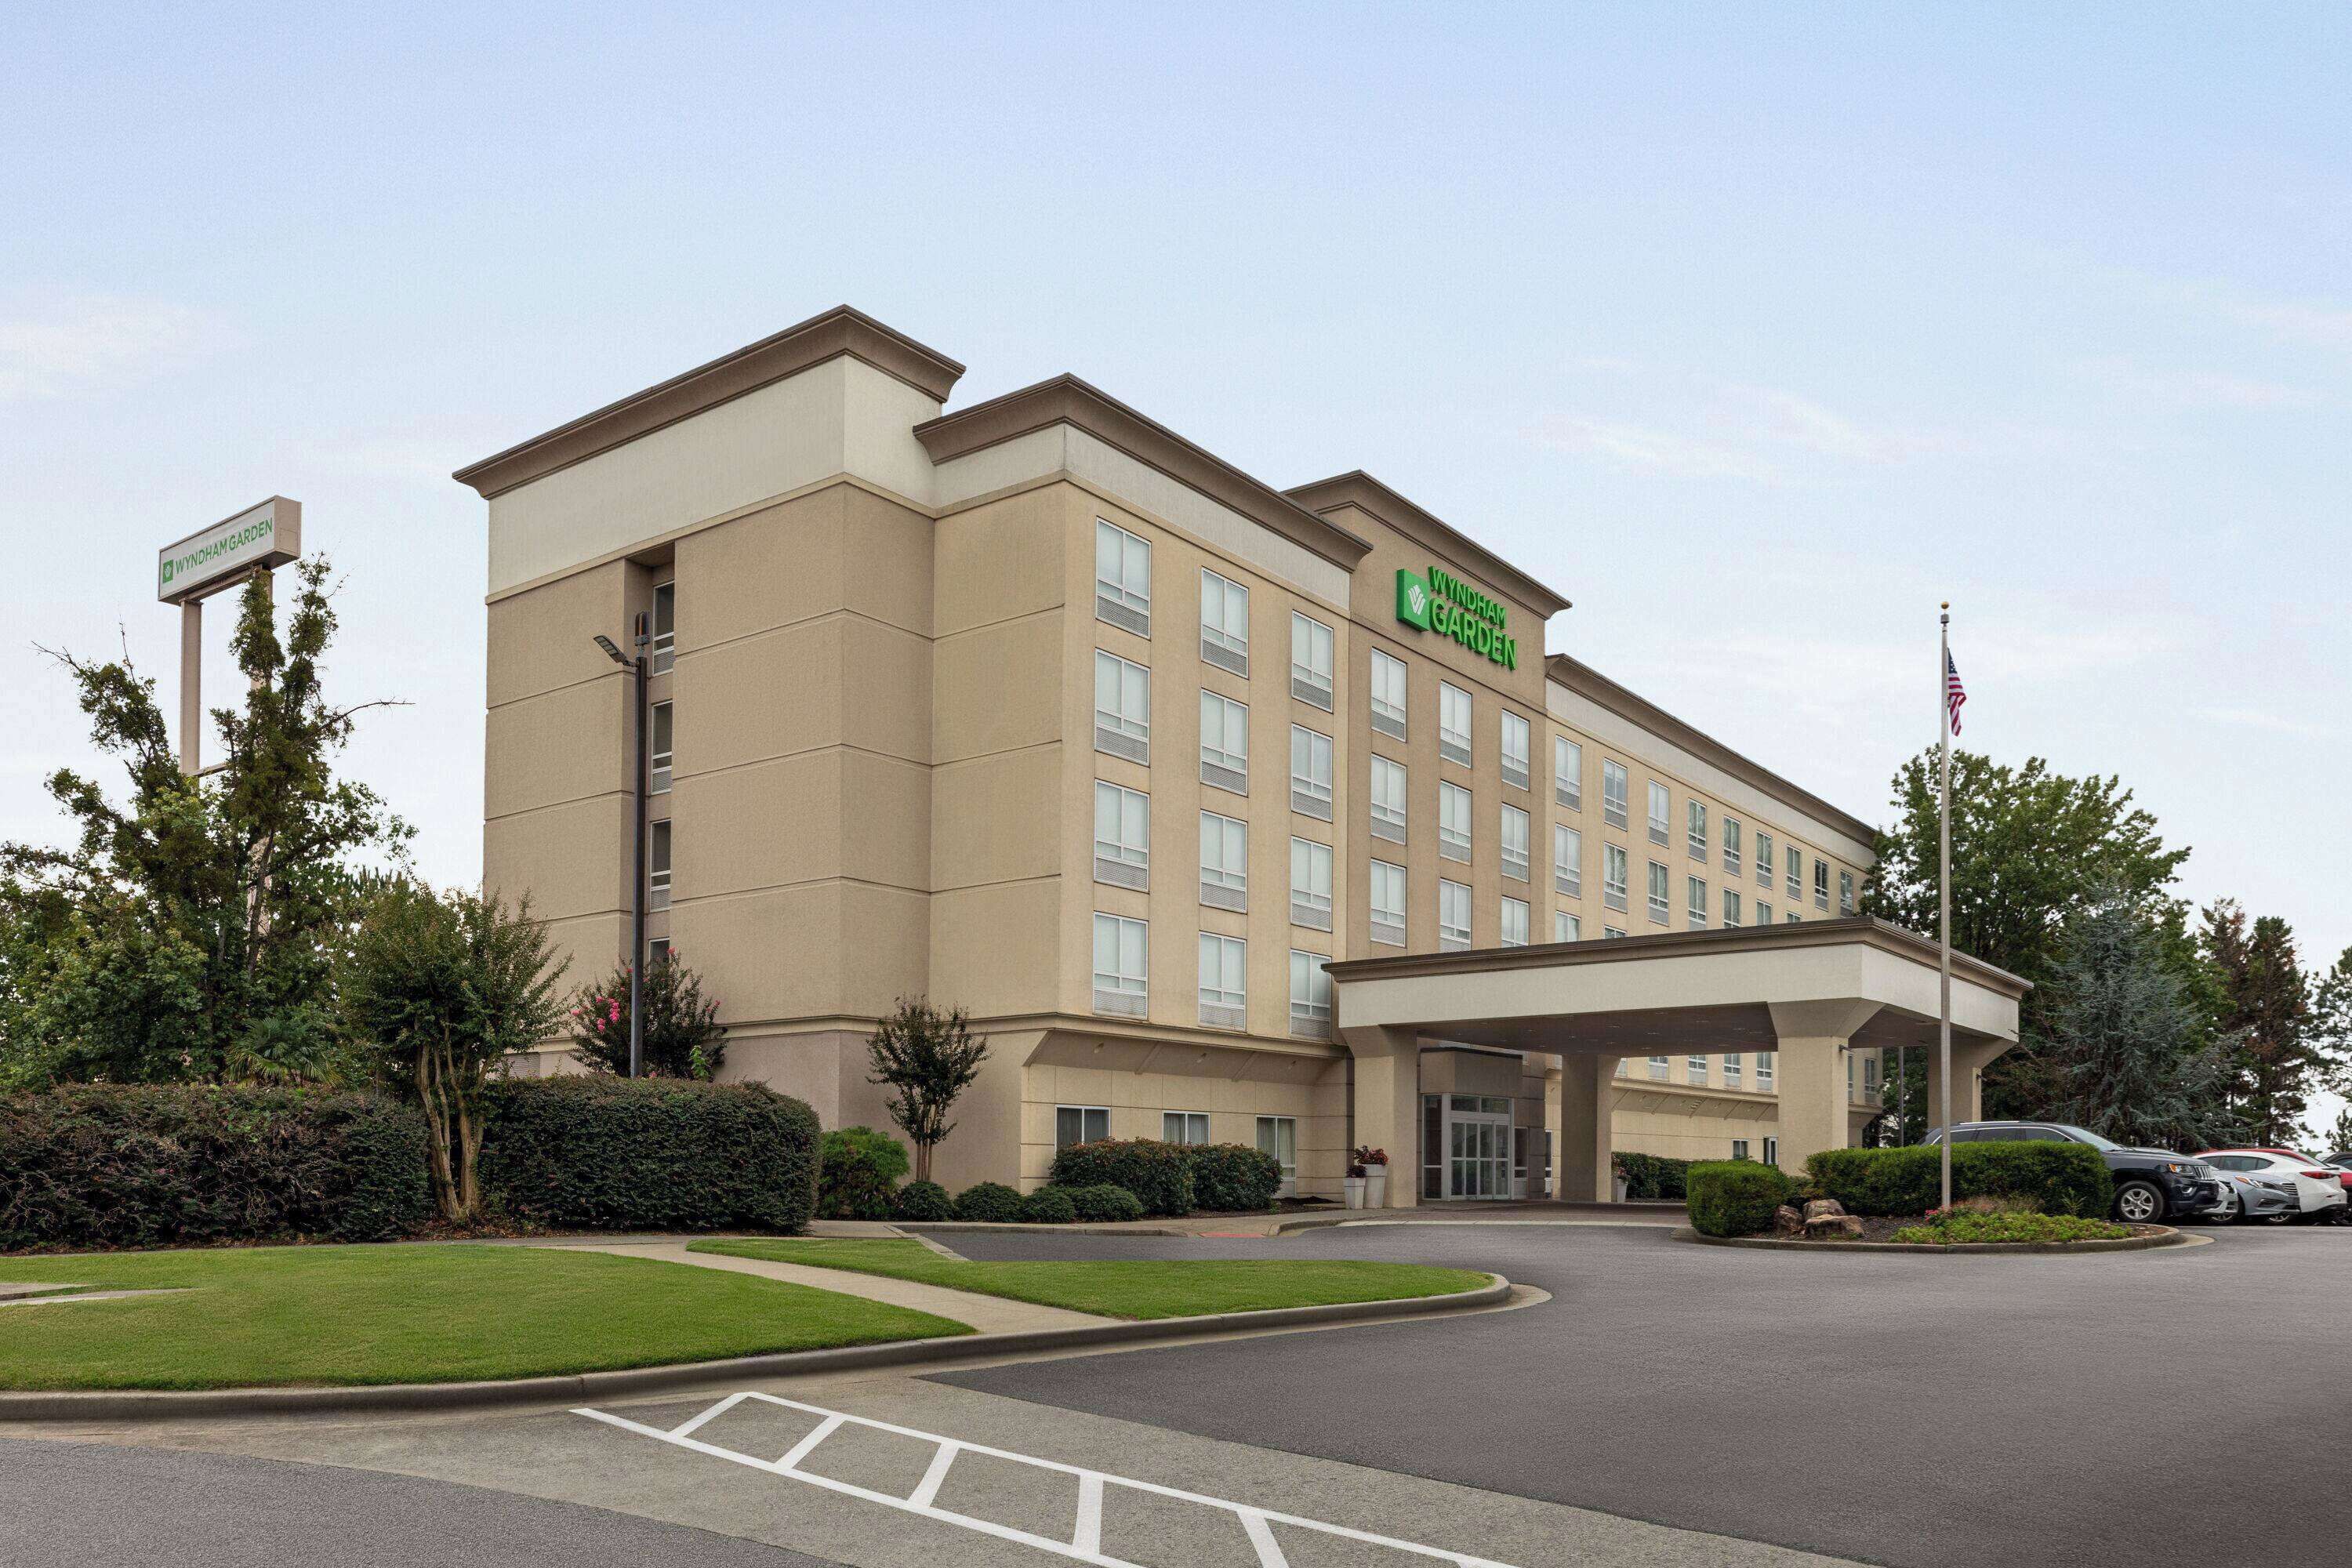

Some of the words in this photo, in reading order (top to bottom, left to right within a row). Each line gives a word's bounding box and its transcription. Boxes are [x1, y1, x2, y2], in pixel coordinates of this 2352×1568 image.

[176, 539, 227, 574] WYNDHAM
[229, 517, 273, 551] GARDEN
[1428, 566, 1506, 629] WYNDHAM
[1429, 597, 1517, 670] GARDEN
